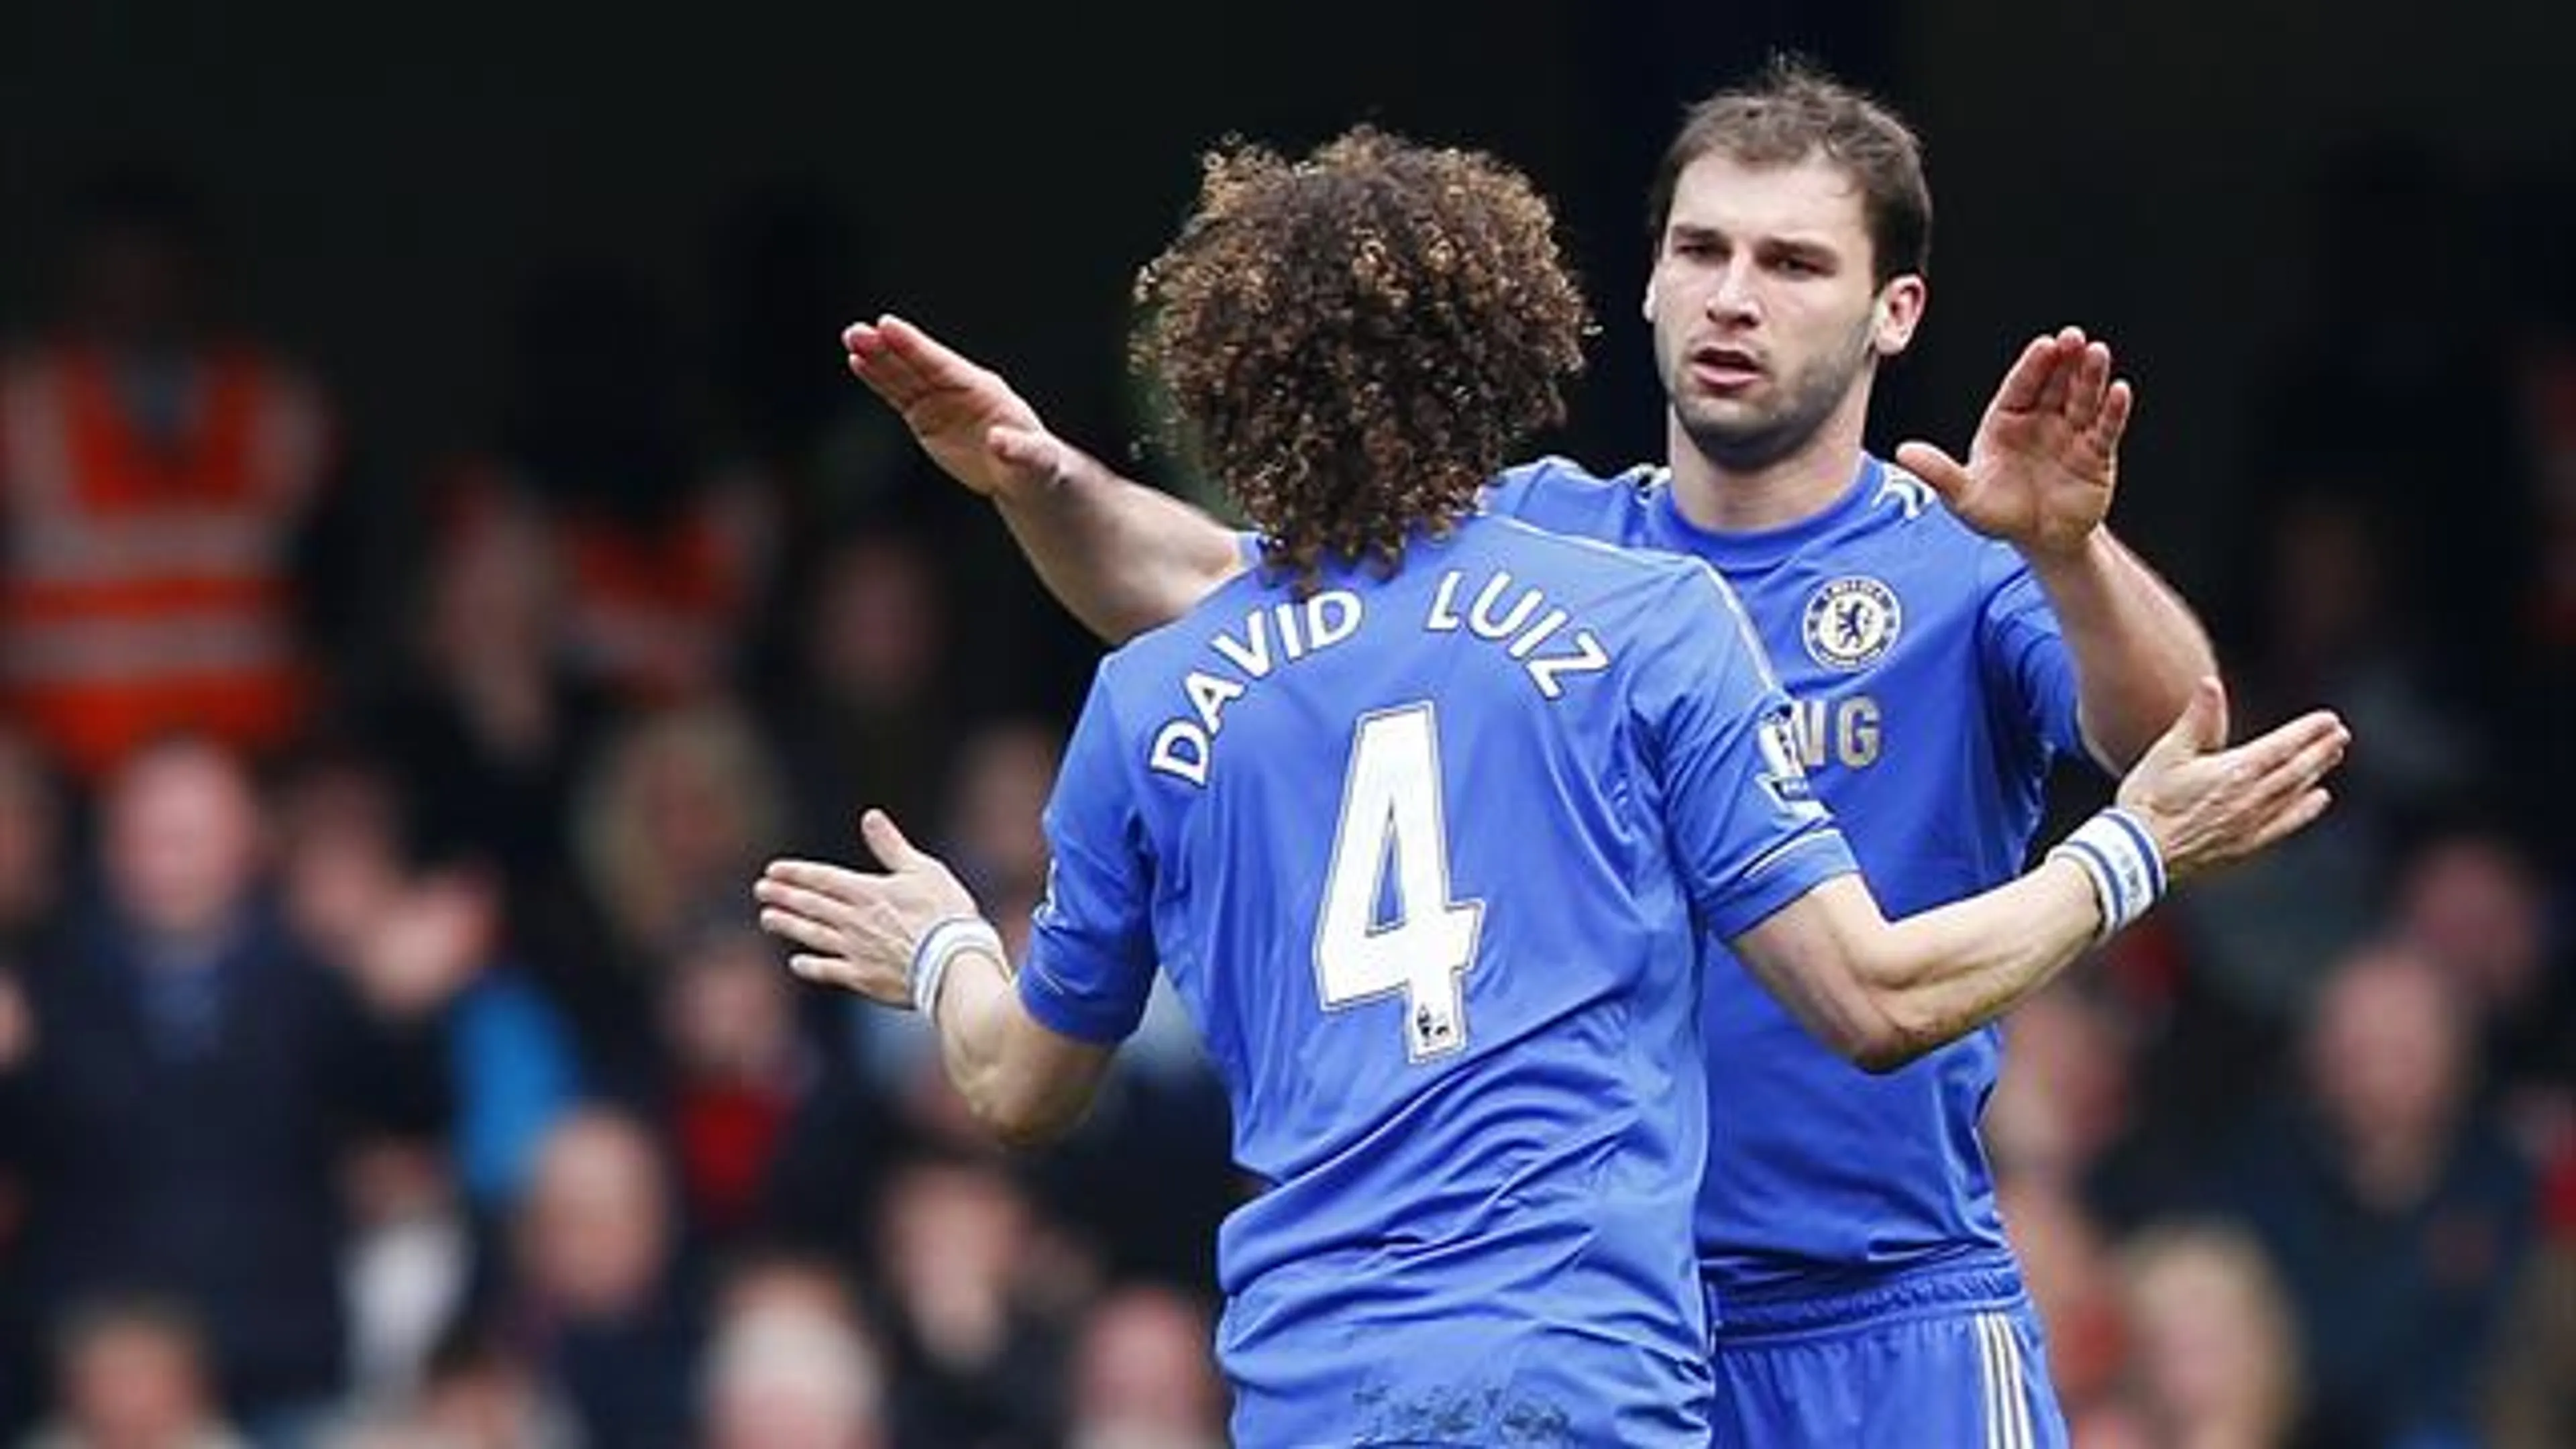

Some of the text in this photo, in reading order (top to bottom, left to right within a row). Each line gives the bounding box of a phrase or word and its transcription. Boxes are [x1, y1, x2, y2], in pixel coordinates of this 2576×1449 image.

[1150, 571, 1610, 789] DAVID LUIZ
[1313, 700, 1486, 1064] 4
